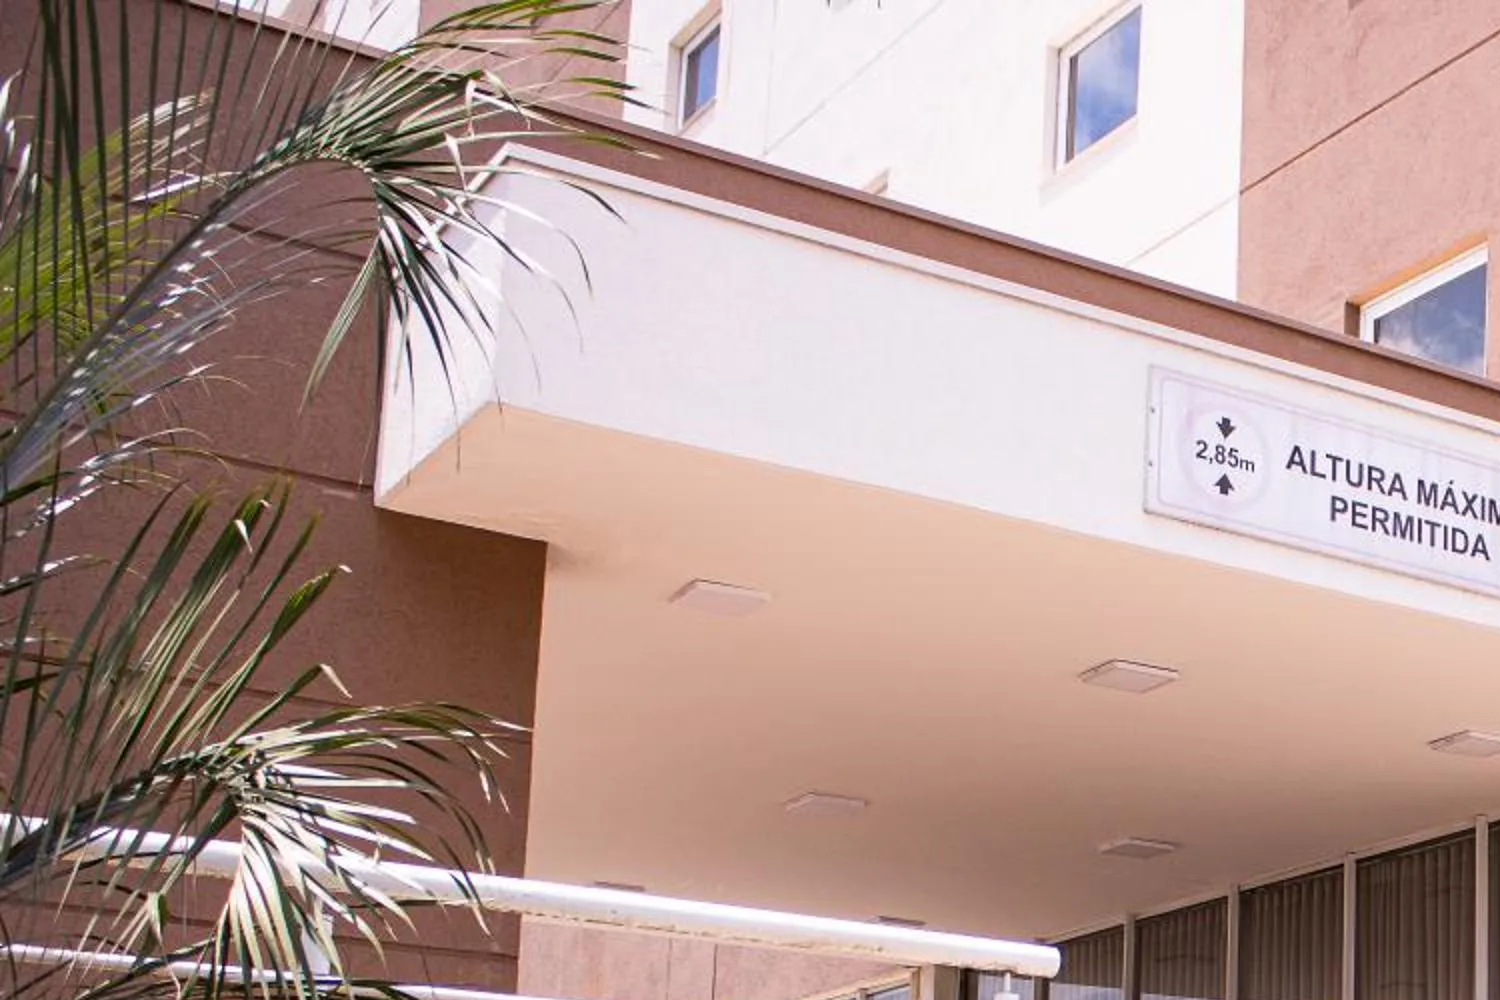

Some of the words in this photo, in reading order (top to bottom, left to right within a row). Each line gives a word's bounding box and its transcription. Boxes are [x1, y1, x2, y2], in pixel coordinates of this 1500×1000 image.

[1196, 439, 1255, 473] 2,85m
[1285, 445, 1408, 501] ALTURA
[1330, 495, 1491, 561] PERMITIDA
